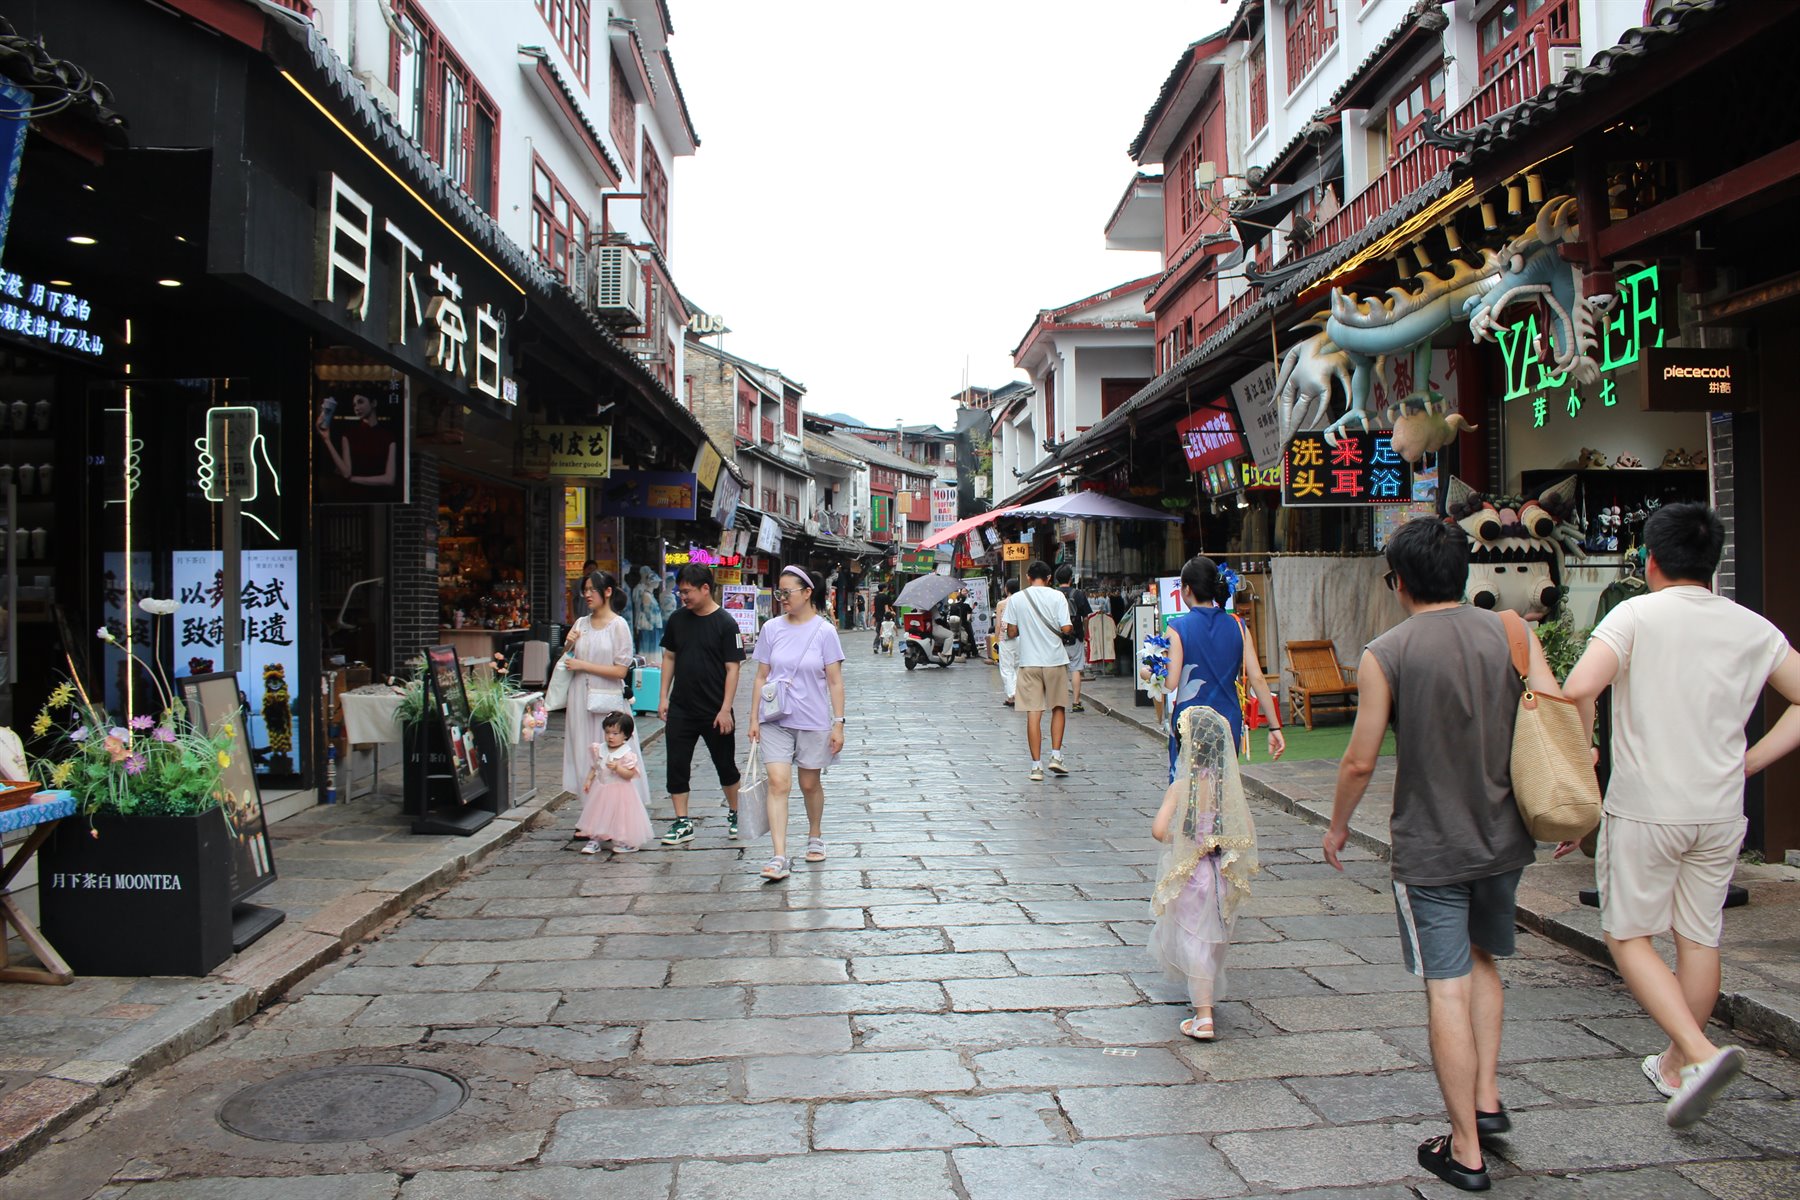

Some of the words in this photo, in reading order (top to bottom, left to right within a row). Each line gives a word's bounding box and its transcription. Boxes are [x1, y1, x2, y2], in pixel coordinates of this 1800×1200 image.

[28, 283, 91, 321] 月下茶白
[327, 172, 500, 399] 月下茶白
[0, 303, 104, 356] 材走出十万大山
[1664, 365, 1731, 380] piececool
[1709, 382, 1731, 394] 拼酷
[1291, 437, 1324, 498] 洗头
[1331, 437, 1364, 497] 采耳
[1369, 437, 1402, 498] 足浴
[933, 489, 956, 501] MOJO
[411, 753, 446, 763] 月茶白
[52, 873, 111, 889] 月下茶白
[115, 874, 182, 890] MOONTEA
